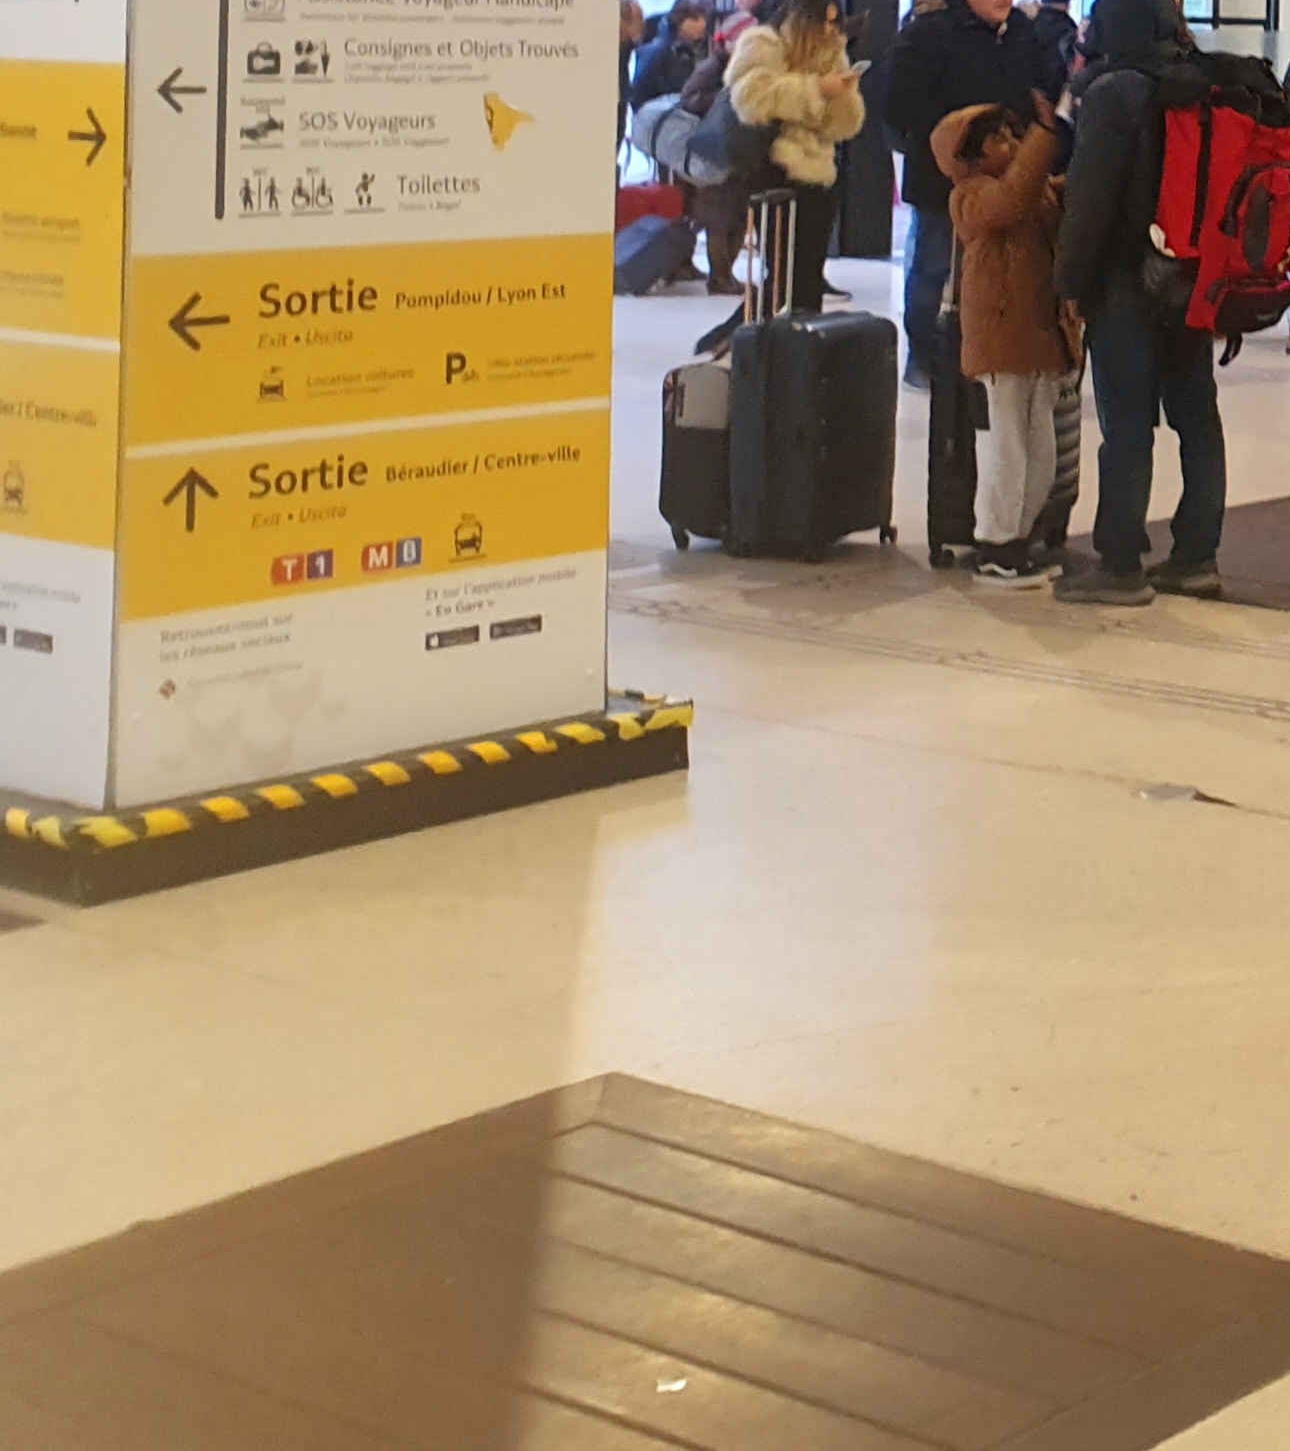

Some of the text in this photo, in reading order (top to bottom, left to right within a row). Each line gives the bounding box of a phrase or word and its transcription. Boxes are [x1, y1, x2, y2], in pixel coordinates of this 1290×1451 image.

[344, 37, 579, 61] Consignes et Objets Trouvés
[299, 110, 436, 134] SOS Voyageurs
[397, 173, 481, 196] Toilettes
[258, 277, 378, 318] Sortie
[395, 289, 482, 310] Pompidou
[498, 286, 537, 305] Lyon
[542, 283, 566, 299] Est
[248, 453, 369, 499] Sortie
[385, 459, 470, 483] Béraudier
[484, 445, 581, 471] Centre-ville
